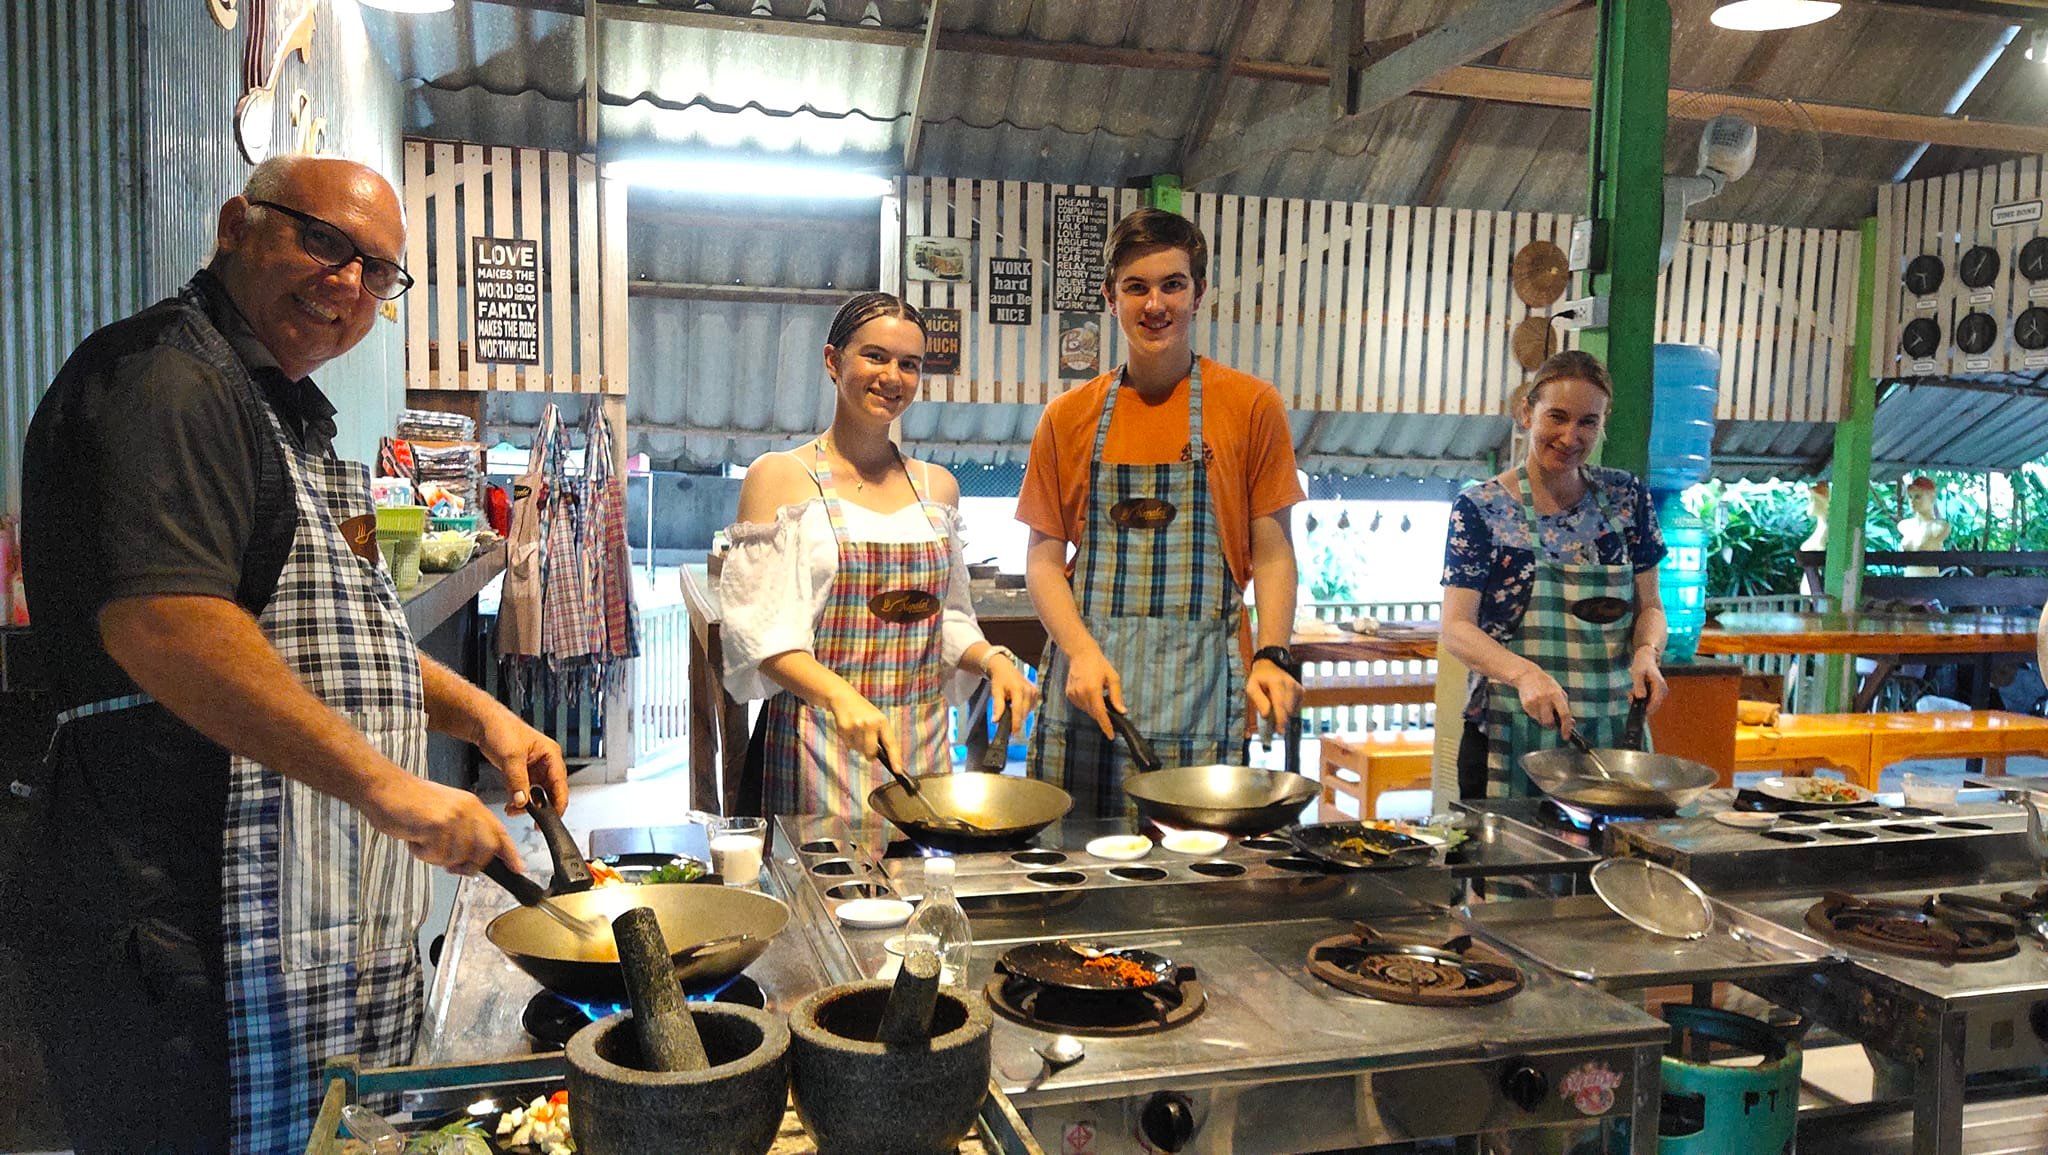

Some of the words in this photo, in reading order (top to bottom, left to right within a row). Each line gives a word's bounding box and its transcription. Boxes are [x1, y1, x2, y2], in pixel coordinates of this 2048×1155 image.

[1057, 198, 1090, 207] DREAM
[1057, 206, 1093, 216] COMPLAIN
[1057, 214, 1089, 224] LISTEN
[1057, 222, 1081, 231] TALK
[1057, 230, 1081, 239] LOVE
[1057, 238, 1089, 247] ARGUE
[1057, 246, 1082, 255] HOPE
[478, 244, 535, 268] LOVE
[1057, 254, 1081, 262] FEAR
[991, 261, 1032, 275] WORK
[1057, 262, 1087, 270] RELAX
[477, 268, 513, 280] MAKES
[515, 270, 535, 281] THE
[1056, 270, 1089, 279] WORRY
[995, 277, 1028, 291] hard
[1056, 278, 1086, 287] BELIEVE
[477, 282, 514, 299] WORLD
[514, 283, 535, 294] GO
[1056, 285, 1087, 294] DOUBT
[990, 293, 1015, 306] and
[1016, 294, 1032, 306] Be
[1056, 293, 1080, 301] PLAY
[1056, 301, 1084, 309] WORK
[478, 301, 537, 320] FAMILY
[997, 309, 1025, 322] NICE
[478, 319, 503, 337] MAKES
[503, 320, 519, 338] THE
[519, 321, 537, 340] RIDE
[479, 339, 537, 360] WORTHWHILE
